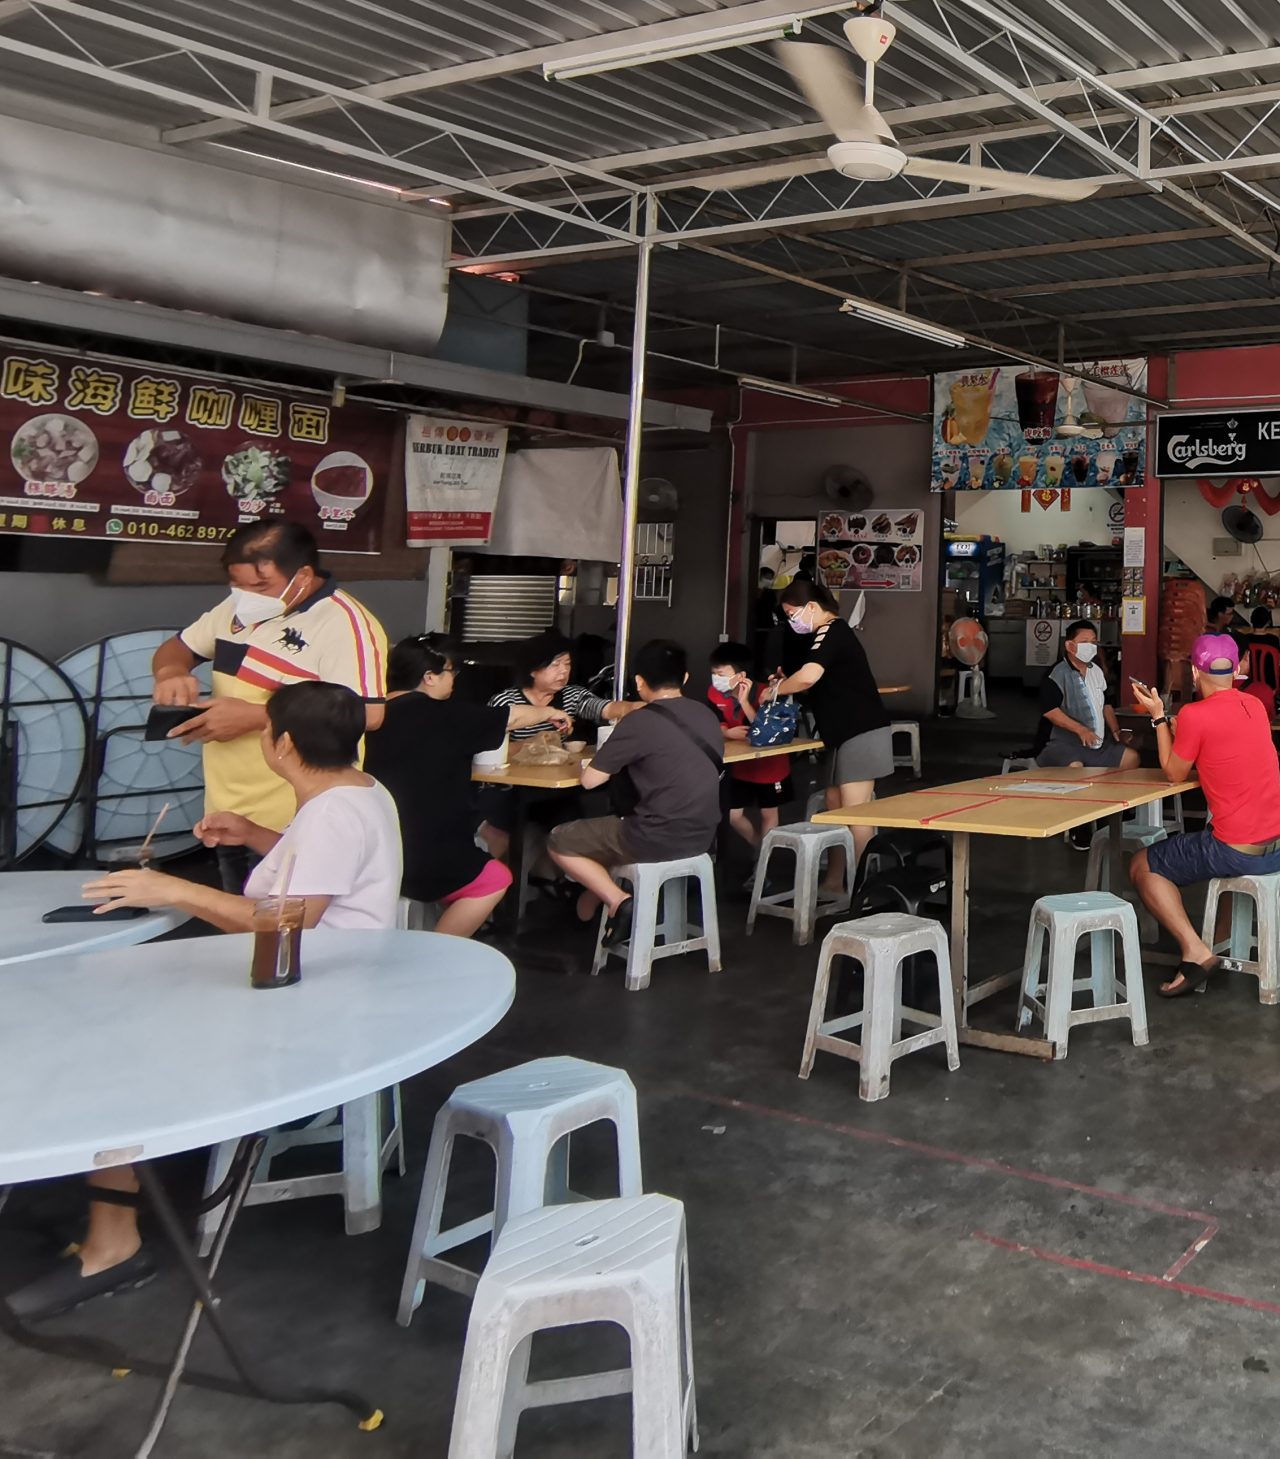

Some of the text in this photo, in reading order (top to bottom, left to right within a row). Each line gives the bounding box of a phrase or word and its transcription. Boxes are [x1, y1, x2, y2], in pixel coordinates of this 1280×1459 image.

[1166, 434, 1247, 468] Carlsberg
[51, 517, 87, 532] 休息
[127, 521, 195, 538] 010-462
